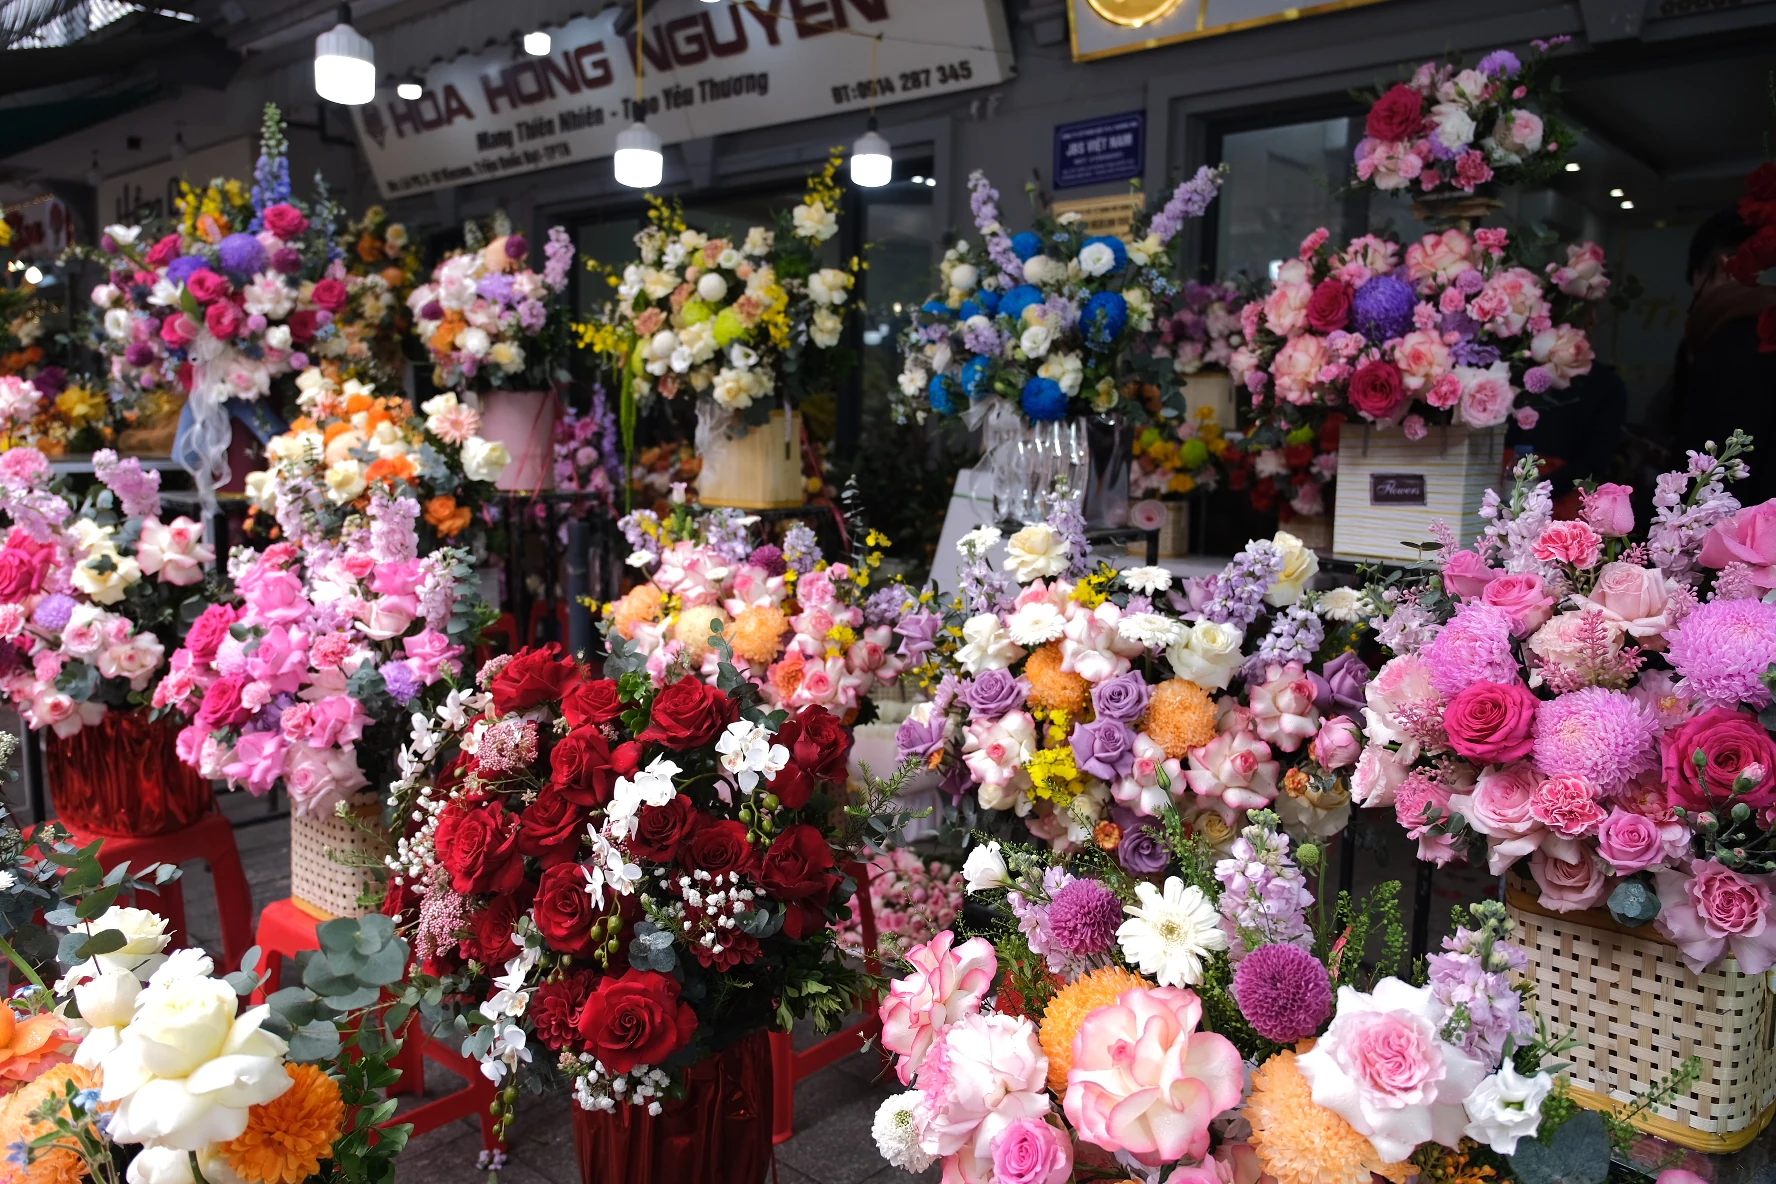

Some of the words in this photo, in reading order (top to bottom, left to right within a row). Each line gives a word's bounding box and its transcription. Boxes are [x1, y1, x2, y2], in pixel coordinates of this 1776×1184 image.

[899, 69, 930, 92] 287
[936, 60, 972, 85] 345
[387, 84, 475, 139] HOA
[1376, 479, 1420, 497] Flowers
